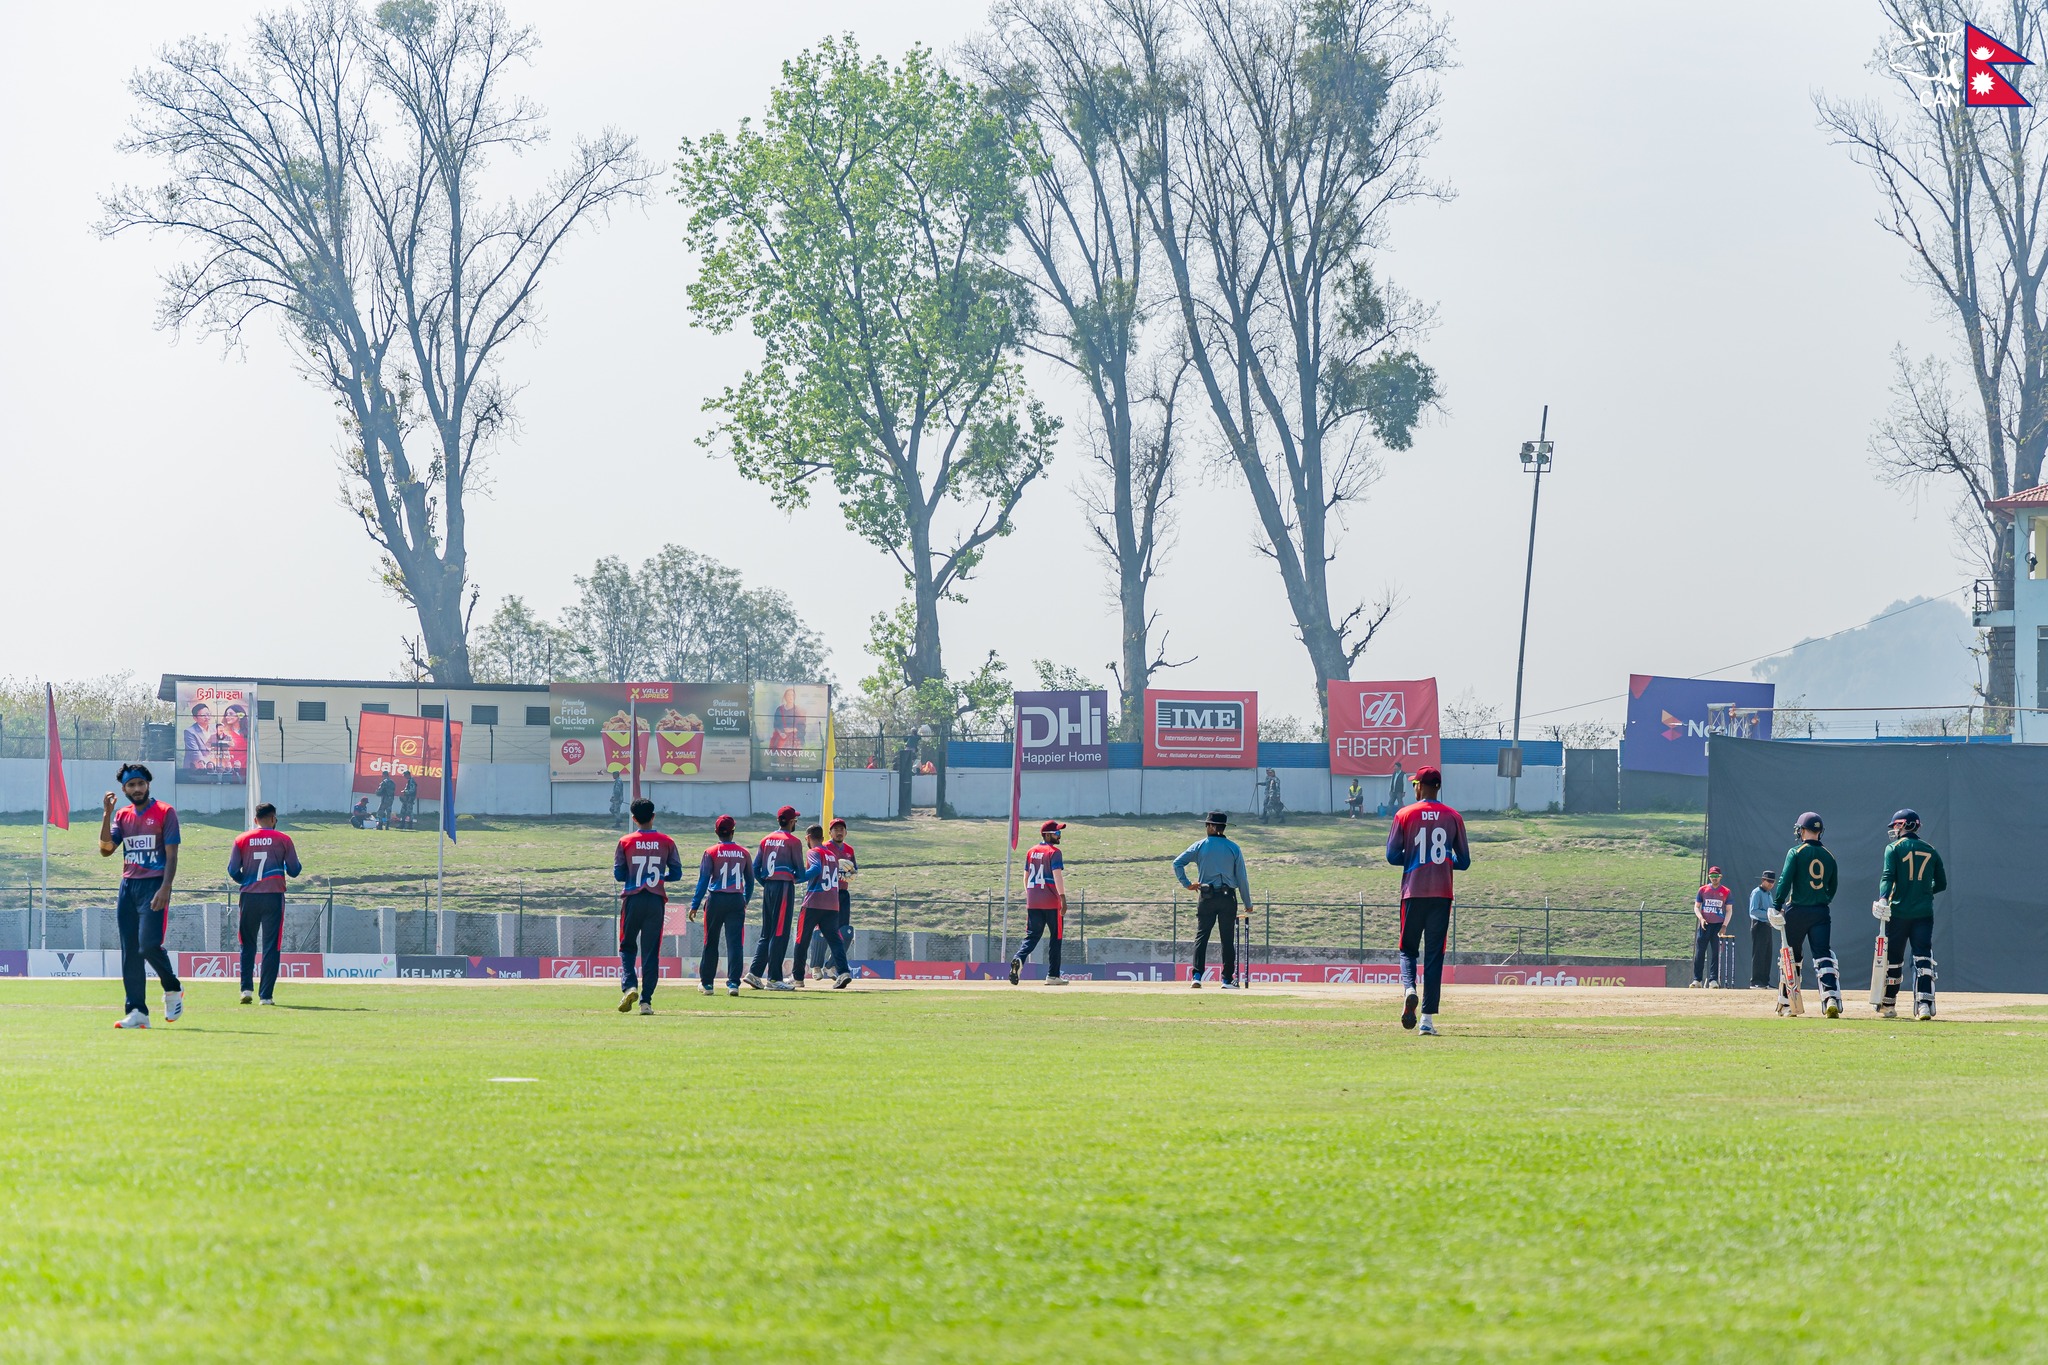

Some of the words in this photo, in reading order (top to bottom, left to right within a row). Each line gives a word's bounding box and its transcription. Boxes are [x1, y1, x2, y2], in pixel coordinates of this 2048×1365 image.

[561, 706, 587, 716] Fried
[707, 708, 746, 717] Chicken
[1171, 708, 1236, 729] IME
[553, 716, 595, 725] Chicken
[715, 717, 738, 727] Lolly
[563, 746, 582, 754] 50%
[763, 749, 817, 758] MANSARRA
[1336, 735, 1433, 758] FIBERNET
[1022, 752, 1066, 765] Happier
[1069, 752, 1102, 762] Home
[1421, 811, 1440, 821] DEV
[249, 838, 273, 847] BINOD
[635, 841, 660, 850] BASIR
[1414, 827, 1448, 865] 18
[253, 852, 268, 881] 7
[631, 855, 661, 888] 75
[767, 851, 777, 877] 6
[1901, 851, 1932, 881] 17
[720, 862, 741, 890] 11
[821, 865, 838, 891] 54
[1026, 863, 1046, 889] 24
[1808, 858, 1824, 890] 9
[400, 968, 452, 978] KELME
